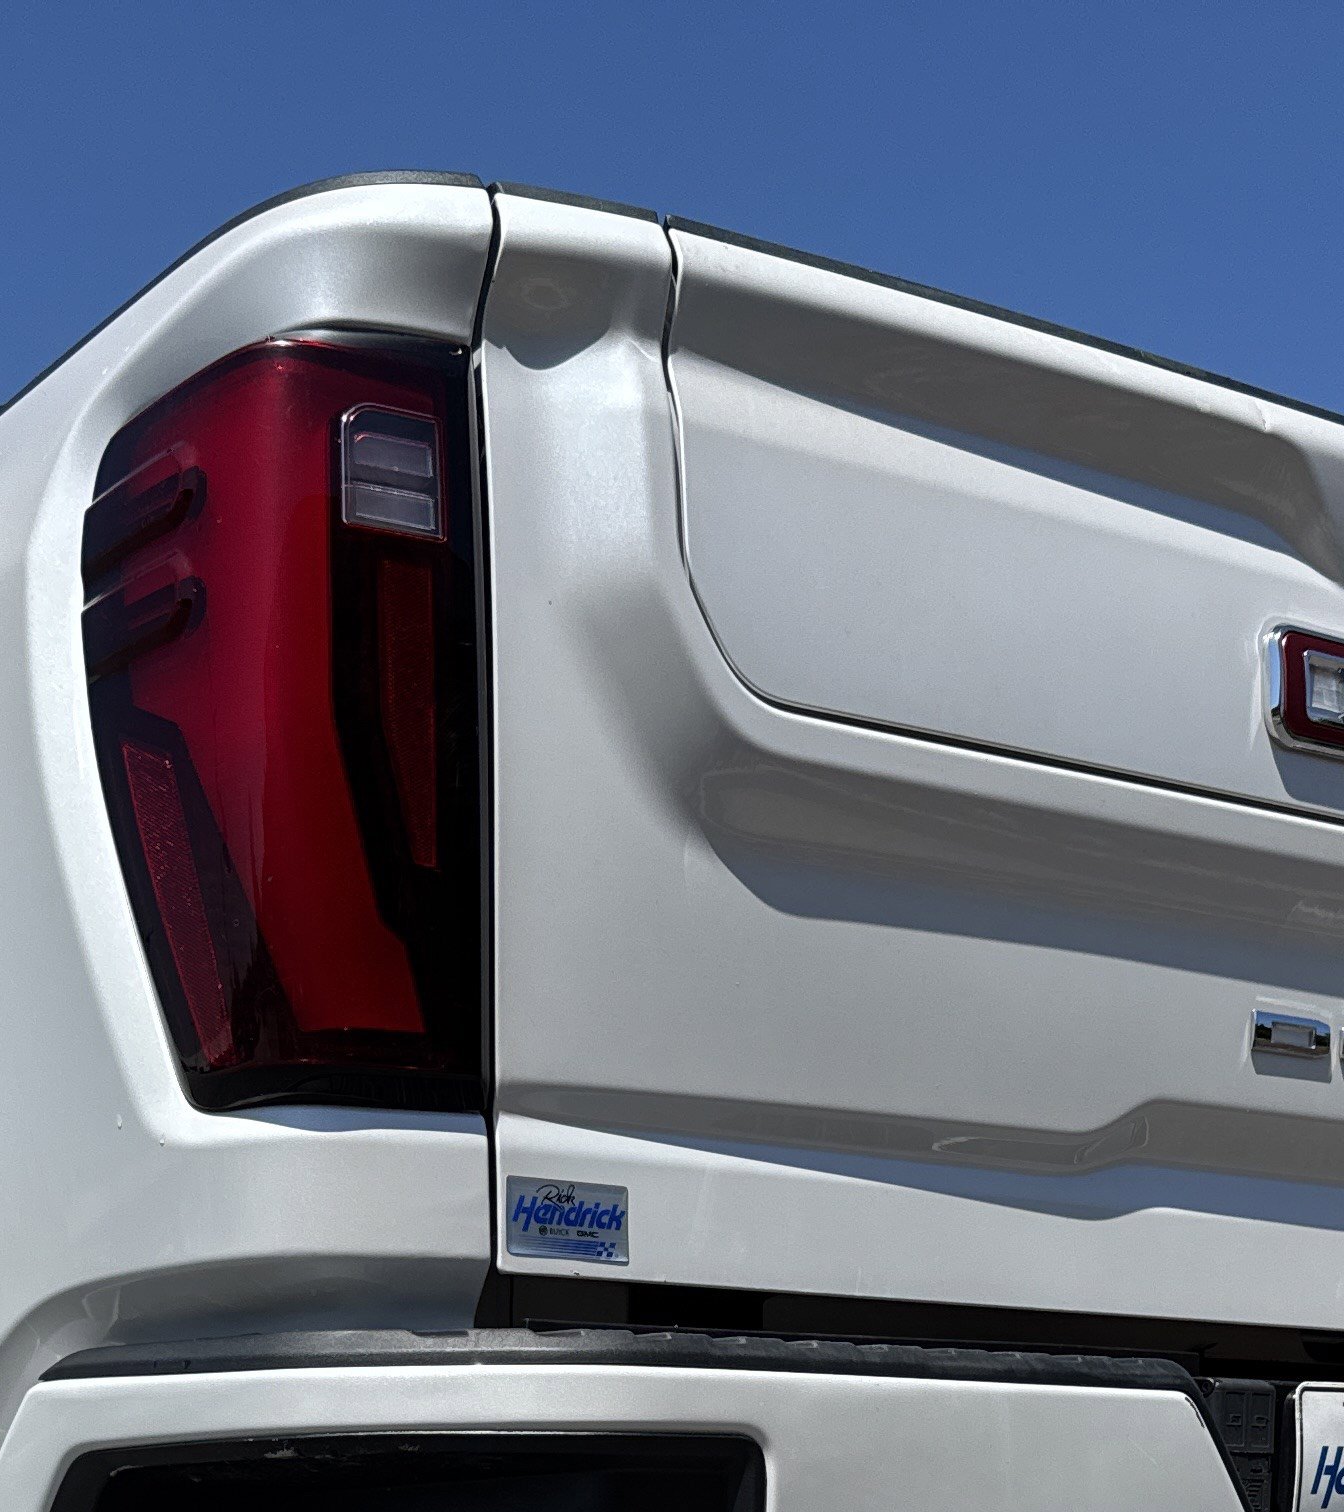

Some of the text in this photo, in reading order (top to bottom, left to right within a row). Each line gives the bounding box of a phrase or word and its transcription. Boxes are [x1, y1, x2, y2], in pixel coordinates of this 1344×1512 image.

[536, 1184, 576, 1209] Rick
[512, 1194, 626, 1233] Hendrick
[576, 1230, 600, 1239] GMC
